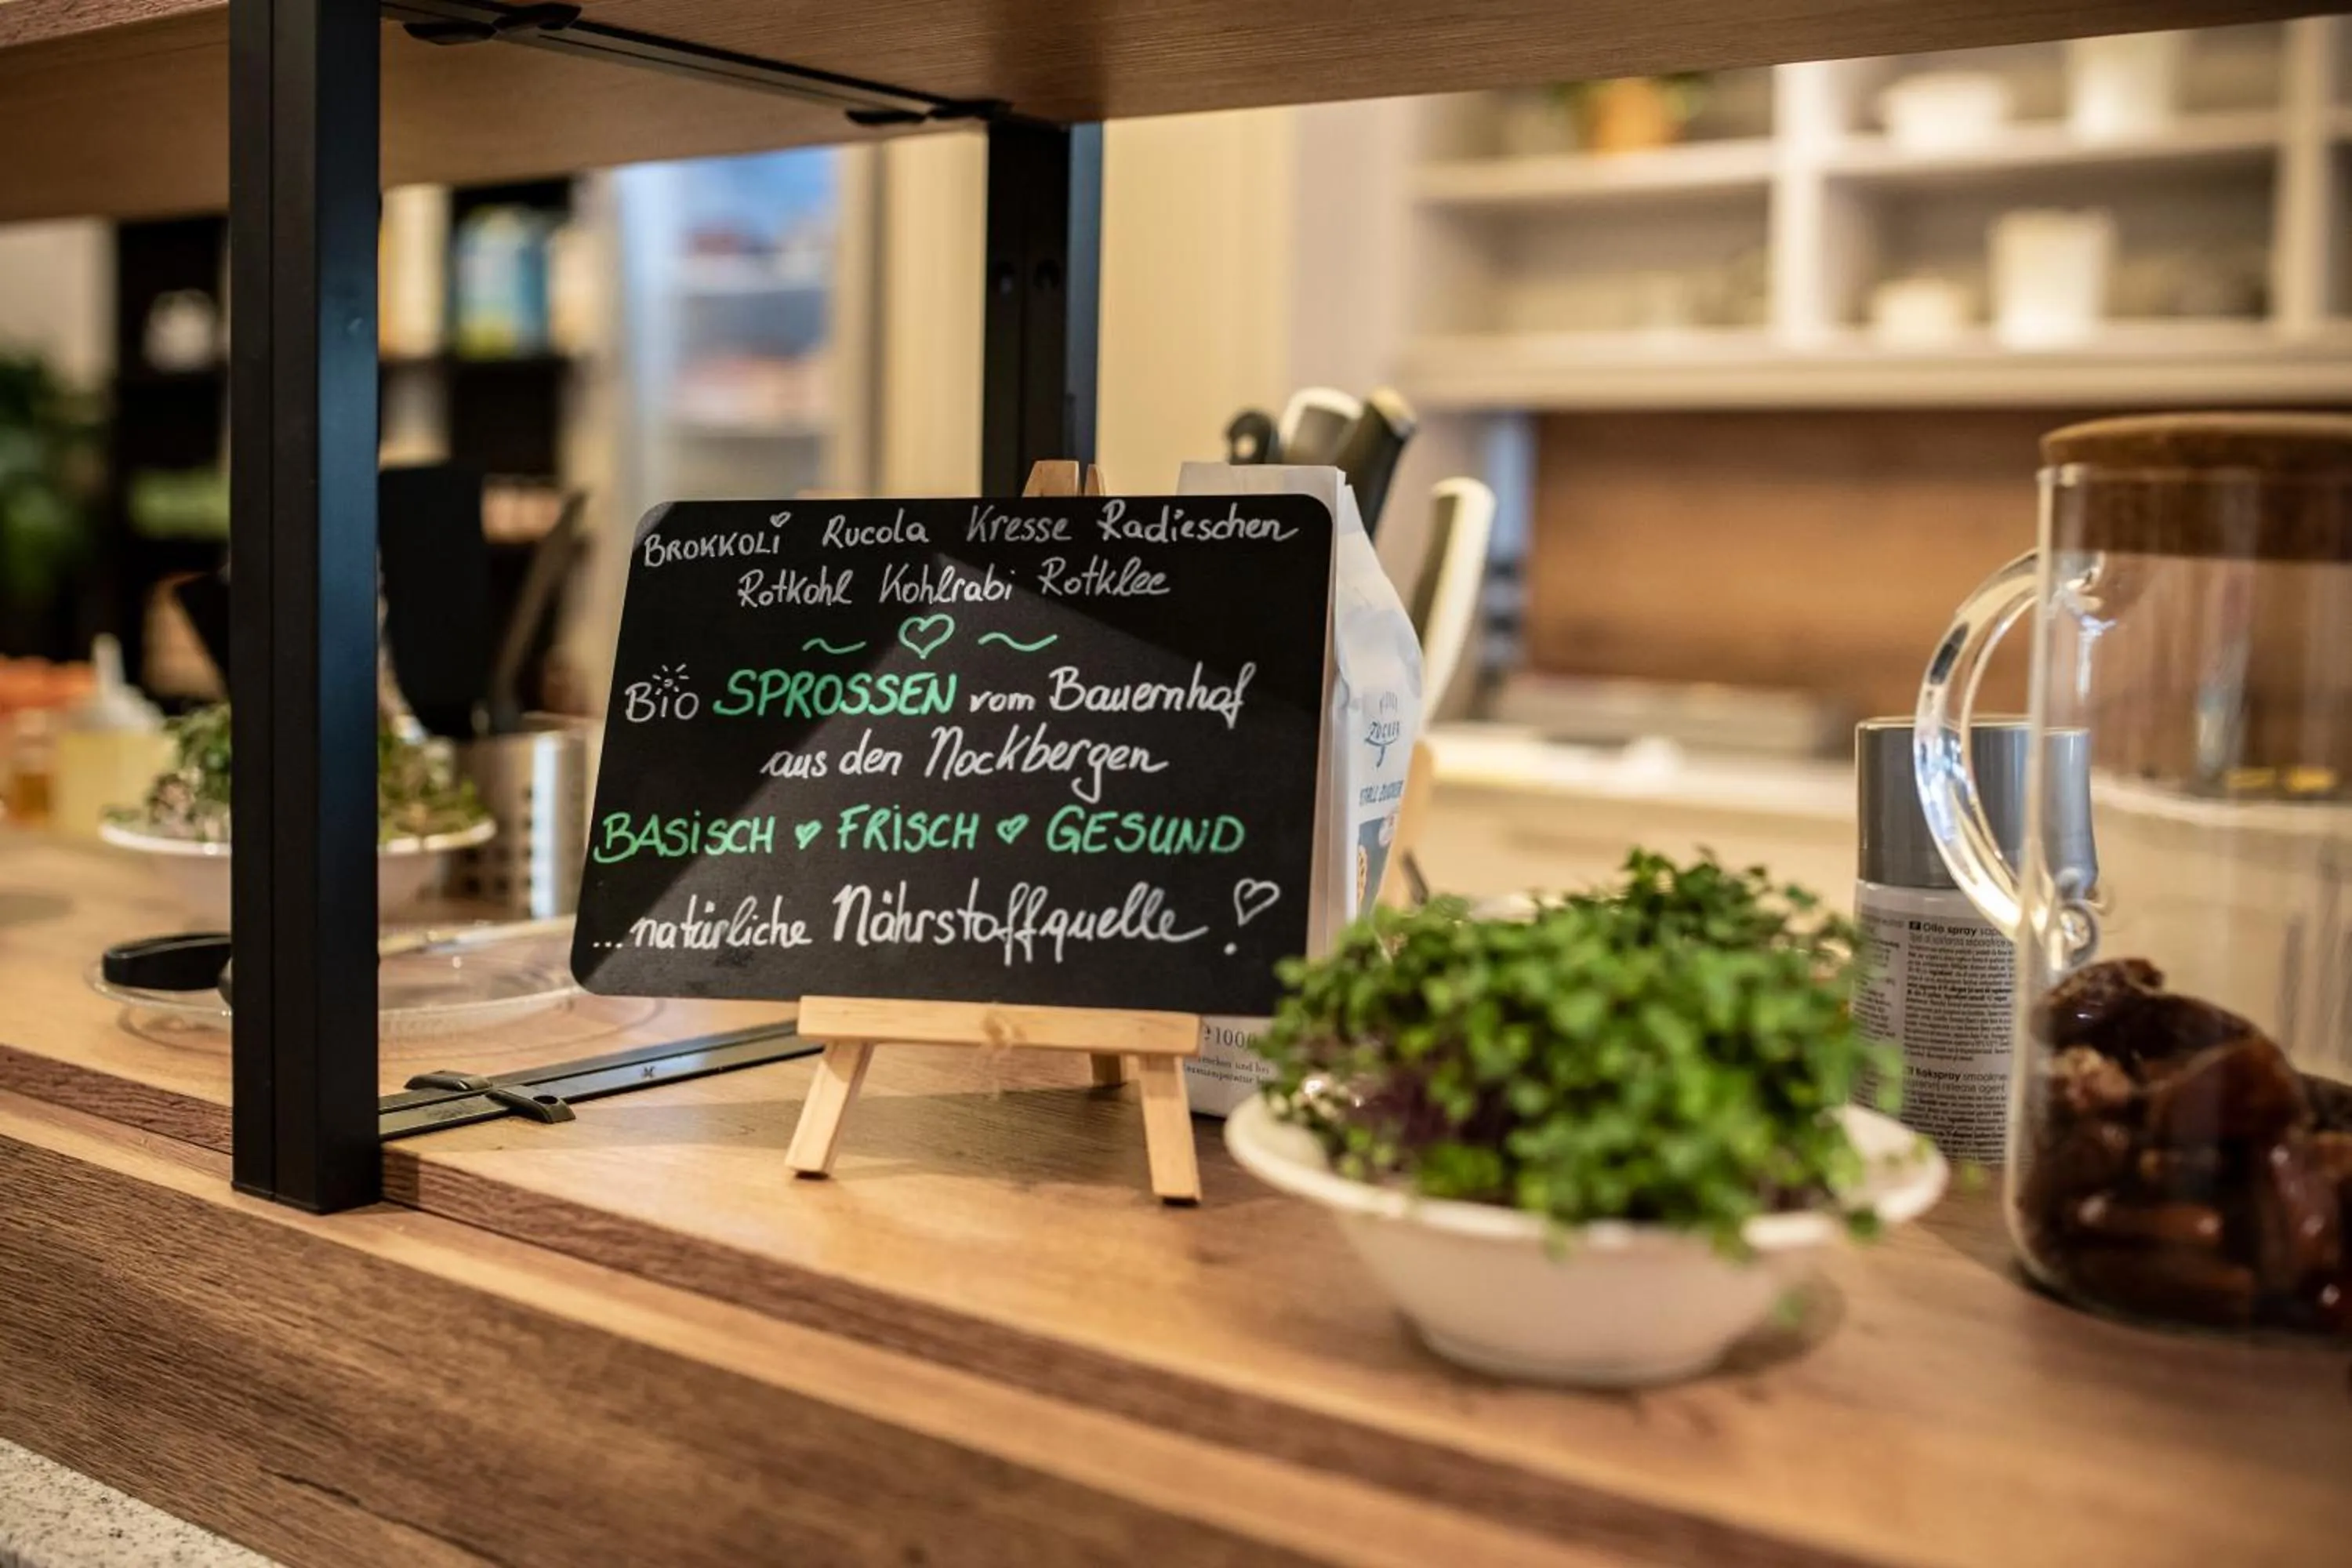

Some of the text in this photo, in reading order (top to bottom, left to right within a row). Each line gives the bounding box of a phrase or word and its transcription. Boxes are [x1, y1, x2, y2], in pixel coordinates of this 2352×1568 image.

[822, 508, 930, 549] Rucola
[965, 504, 1073, 543] Kresse
[1098, 499, 1300, 543] Radieschen
[737, 554, 1171, 608] Rotkohl Kohlrabi Rotklee
[712, 668, 958, 719] SPROSSEN
[969, 691, 1036, 713] vom
[1048, 661, 1256, 730] Bauernhof
[759, 721, 1170, 804] aus den Nockbergen
[1046, 804, 1246, 855] GESUND
[1947, 926, 1976, 937] spray
